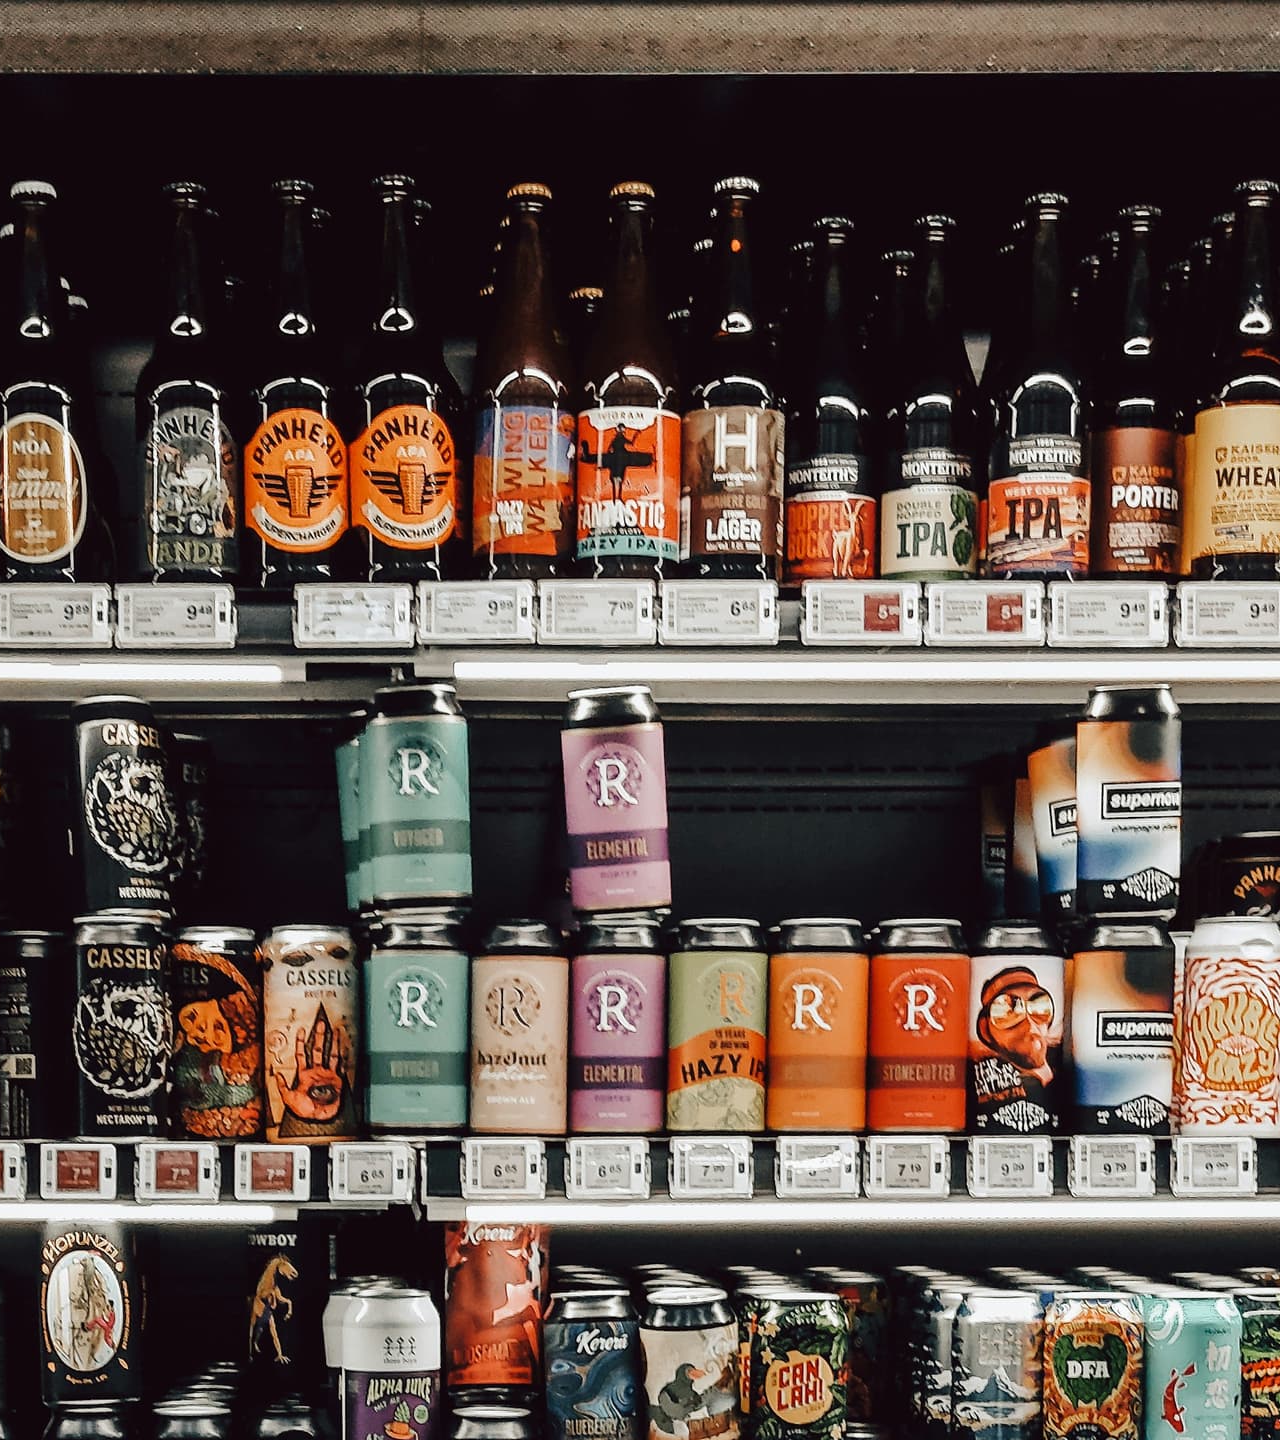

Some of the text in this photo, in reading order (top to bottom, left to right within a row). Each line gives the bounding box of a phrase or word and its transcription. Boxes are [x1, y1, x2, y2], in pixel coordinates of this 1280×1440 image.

[13, 440, 52, 457] MOA
[252, 416, 344, 468] PANHEAD
[363, 414, 453, 464] PANHEAD
[1229, 445, 1280, 456] KAISER
[284, 448, 315, 462] APA
[397, 446, 428, 460] APA
[506, 413, 525, 493] WING
[527, 415, 549, 537] WALKER
[1112, 485, 1179, 512] PORTER
[579, 498, 665, 531] FANTASTIC
[1006, 497, 1064, 540] IPA
[706, 518, 762, 543] LAGER
[897, 525, 948, 559] IPA
[627, 538, 658, 553] IPA
[399, 748, 440, 796] R
[587, 837, 648, 859] ELEMENTAL
[87, 948, 161, 969] CASSELS
[286, 969, 350, 988] CASSELS
[584, 1064, 644, 1084] ELEMENTAL
[682, 1052, 743, 1083] HAZY
[883, 1064, 957, 1084] STONECUTTER
[42, 1231, 122, 1264] HOPUNZEL
[778, 1364, 820, 1387] CAN
[1066, 1361, 1110, 1382] DFA
[367, 1377, 402, 1403] ALPHA
[776, 1382, 824, 1408] LAH!
